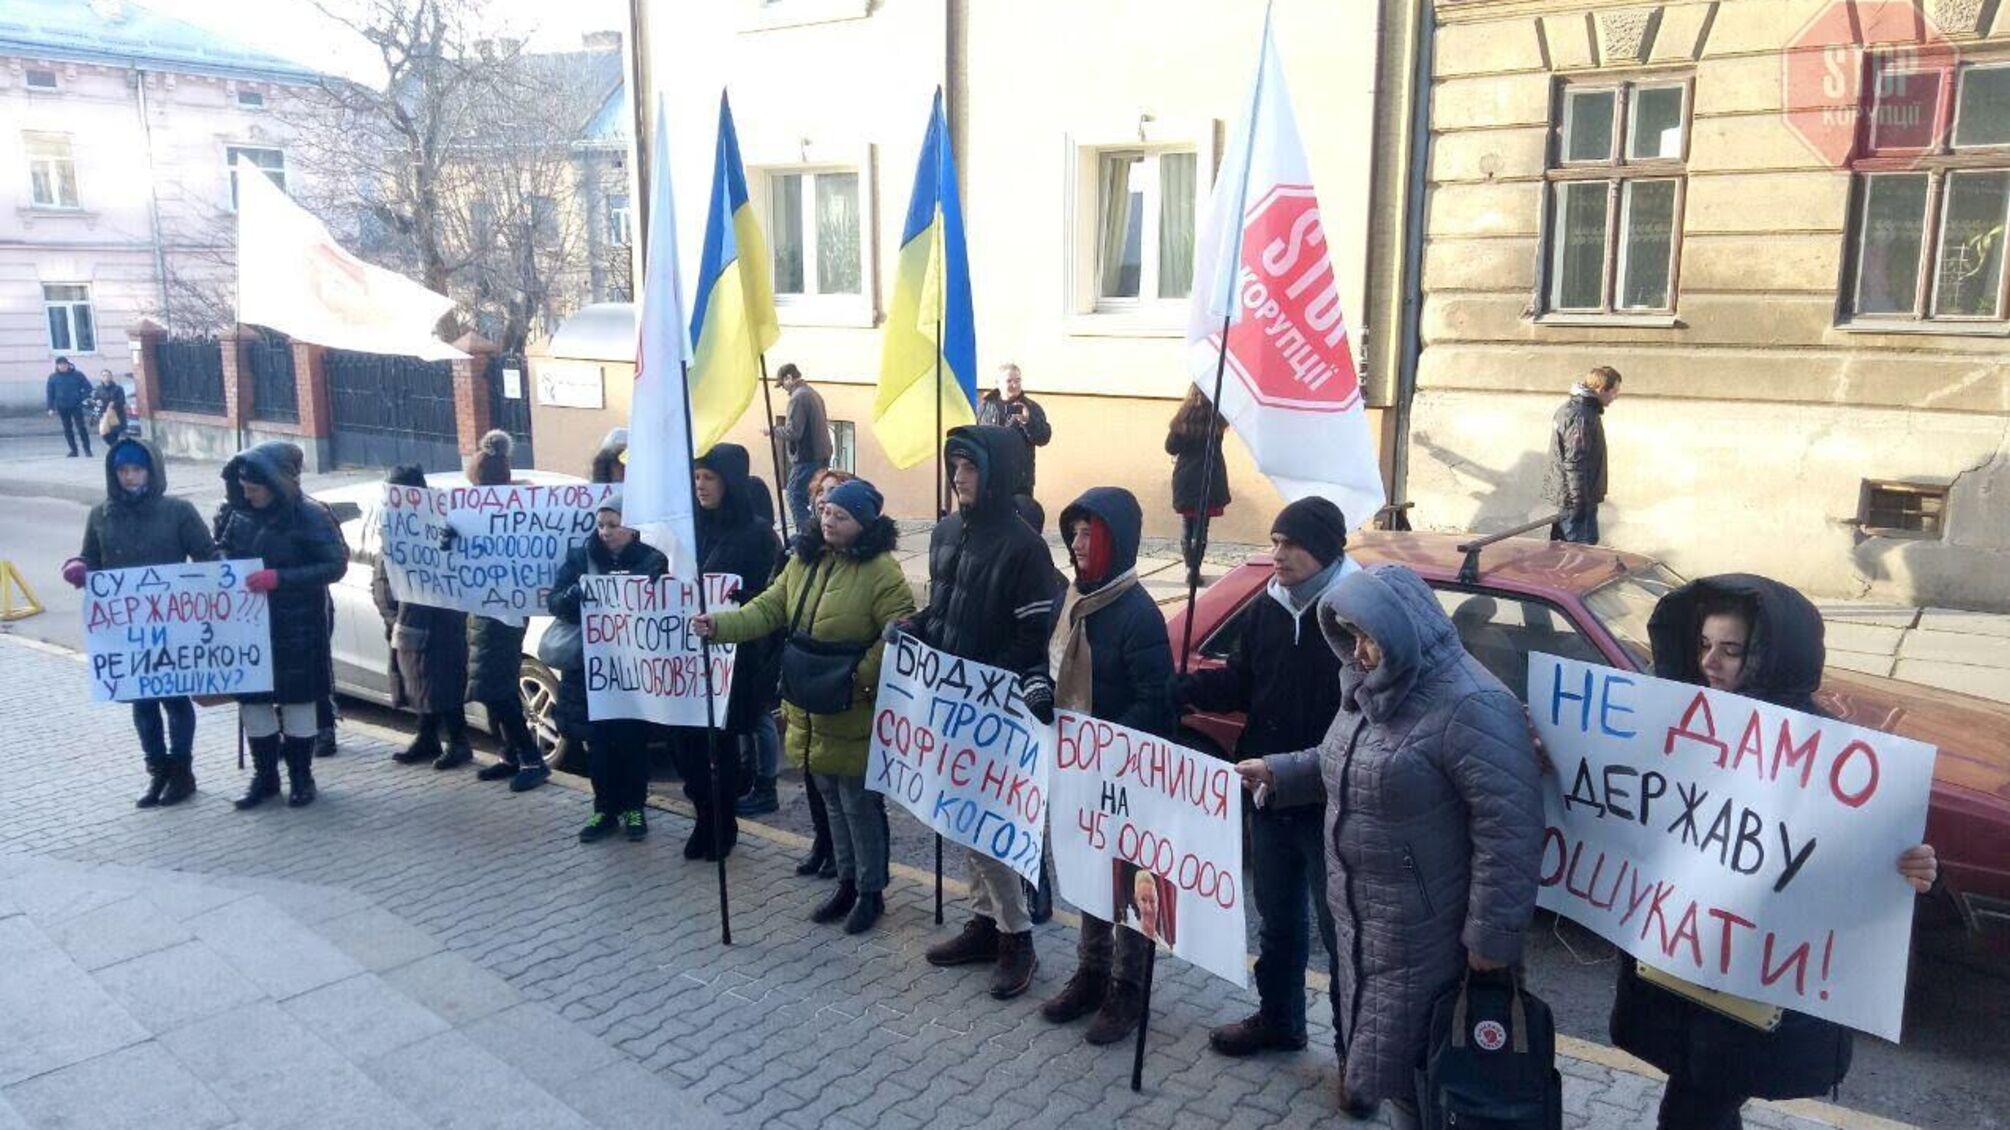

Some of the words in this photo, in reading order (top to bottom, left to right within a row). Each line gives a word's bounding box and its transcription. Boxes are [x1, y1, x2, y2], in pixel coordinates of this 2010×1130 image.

[490, 511, 597, 535] ПРАЦЮ
[91, 567, 170, 597] СУД
[458, 560, 558, 588] СОФІЄН
[128, 626, 167, 648] ЧИ
[587, 614, 632, 646] БОРГ
[589, 655, 640, 692] ВАШ
[896, 635, 1025, 719] БЮДЖЕ
[929, 696, 1040, 776] ПРОТИ
[1551, 663, 1637, 739] НЕ
[1663, 690, 1880, 808] ДАМО
[876, 708, 1041, 824] СОФІЄНКО
[878, 751, 924, 804] ХТО
[1057, 715, 1229, 821] БОРЖНИЦЯ
[1100, 780, 1130, 817] НА
[1564, 756, 1817, 893] ДЕРЖАВУ
[1078, 807, 1109, 850] 45
[1118, 823, 1174, 875] 000
[1178, 853, 1235, 909] 000
